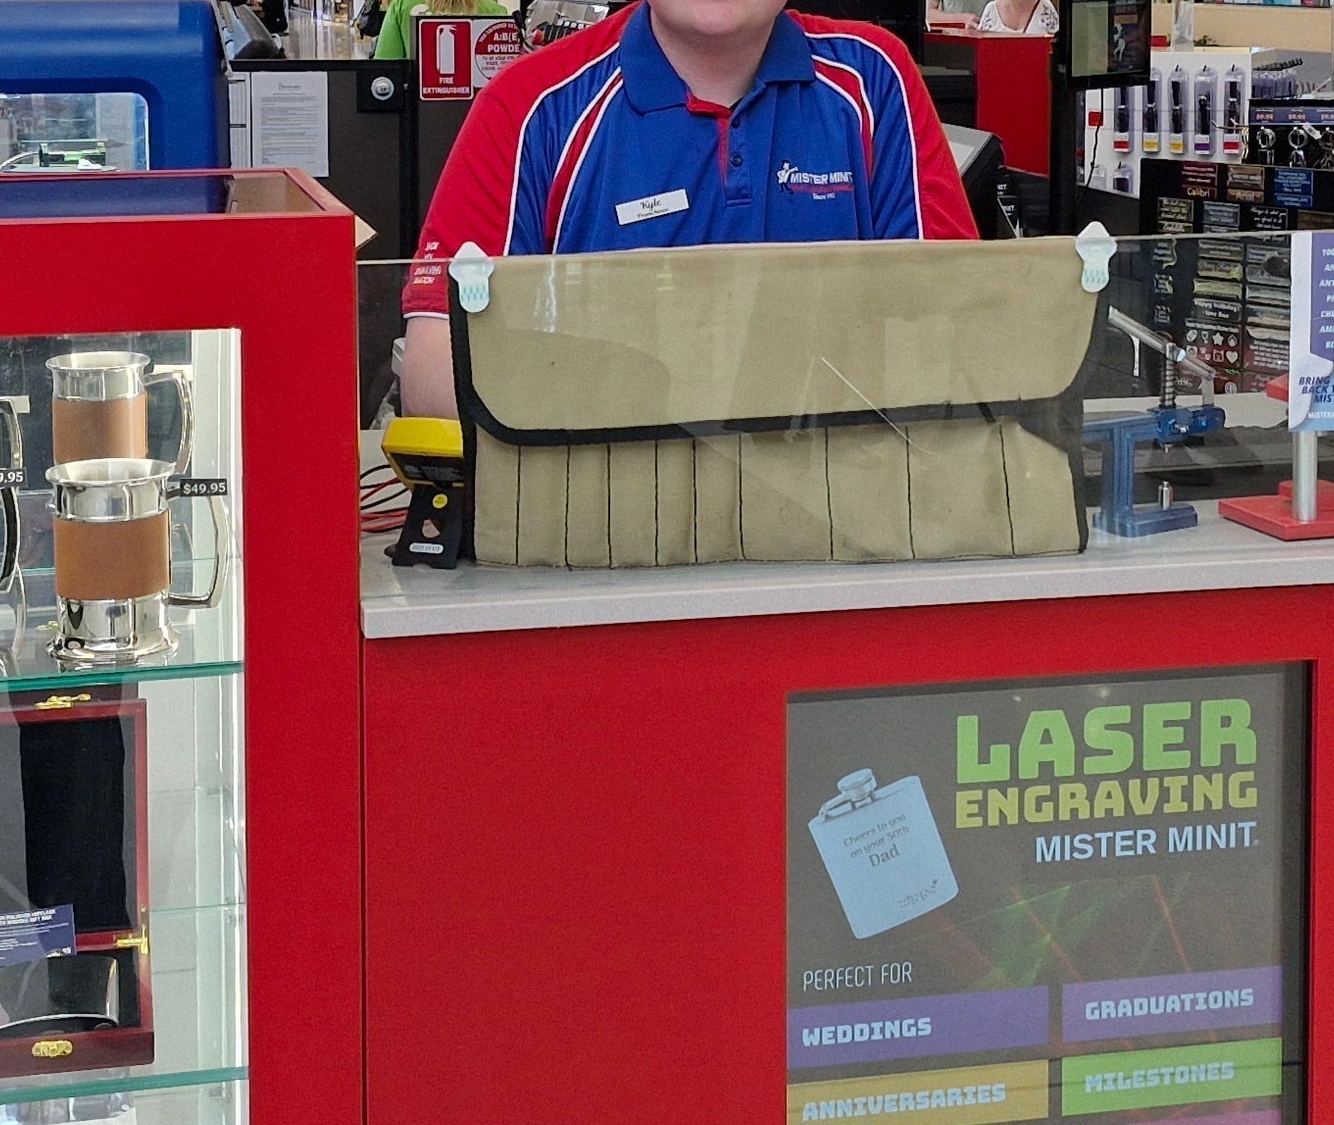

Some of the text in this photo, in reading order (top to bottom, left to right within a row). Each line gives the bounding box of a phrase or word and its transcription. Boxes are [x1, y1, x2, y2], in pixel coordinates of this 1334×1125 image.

[487, 43, 521, 53] POWDE
[423, 86, 470, 94] EXTINGUISHER
[439, 76, 454, 84] FIRE
[790, 171, 828, 185] MISTER
[639, 198, 662, 211] Kyle
[1298, 375, 1331, 386] BRING
[1301, 384, 1329, 395] BACK
[182, 480, 226, 496] $49.95
[955, 698, 1258, 784] LASER
[955, 771, 1259, 829] ENGRAVING
[843, 813, 908, 848] Cheers to you
[850, 826, 910, 859] on your 50th
[1034, 821, 1258, 863] MISTER MINIT
[868, 843, 901, 868] Dad
[802, 961, 913, 993] PERFECT FOR
[1084, 988, 1255, 1021] GRADUATIONS
[802, 1017, 933, 1047] WEDDINGS
[1084, 1060, 1236, 1094] MILESTONES
[802, 1082, 1007, 1121] ANNIVERSARIES
